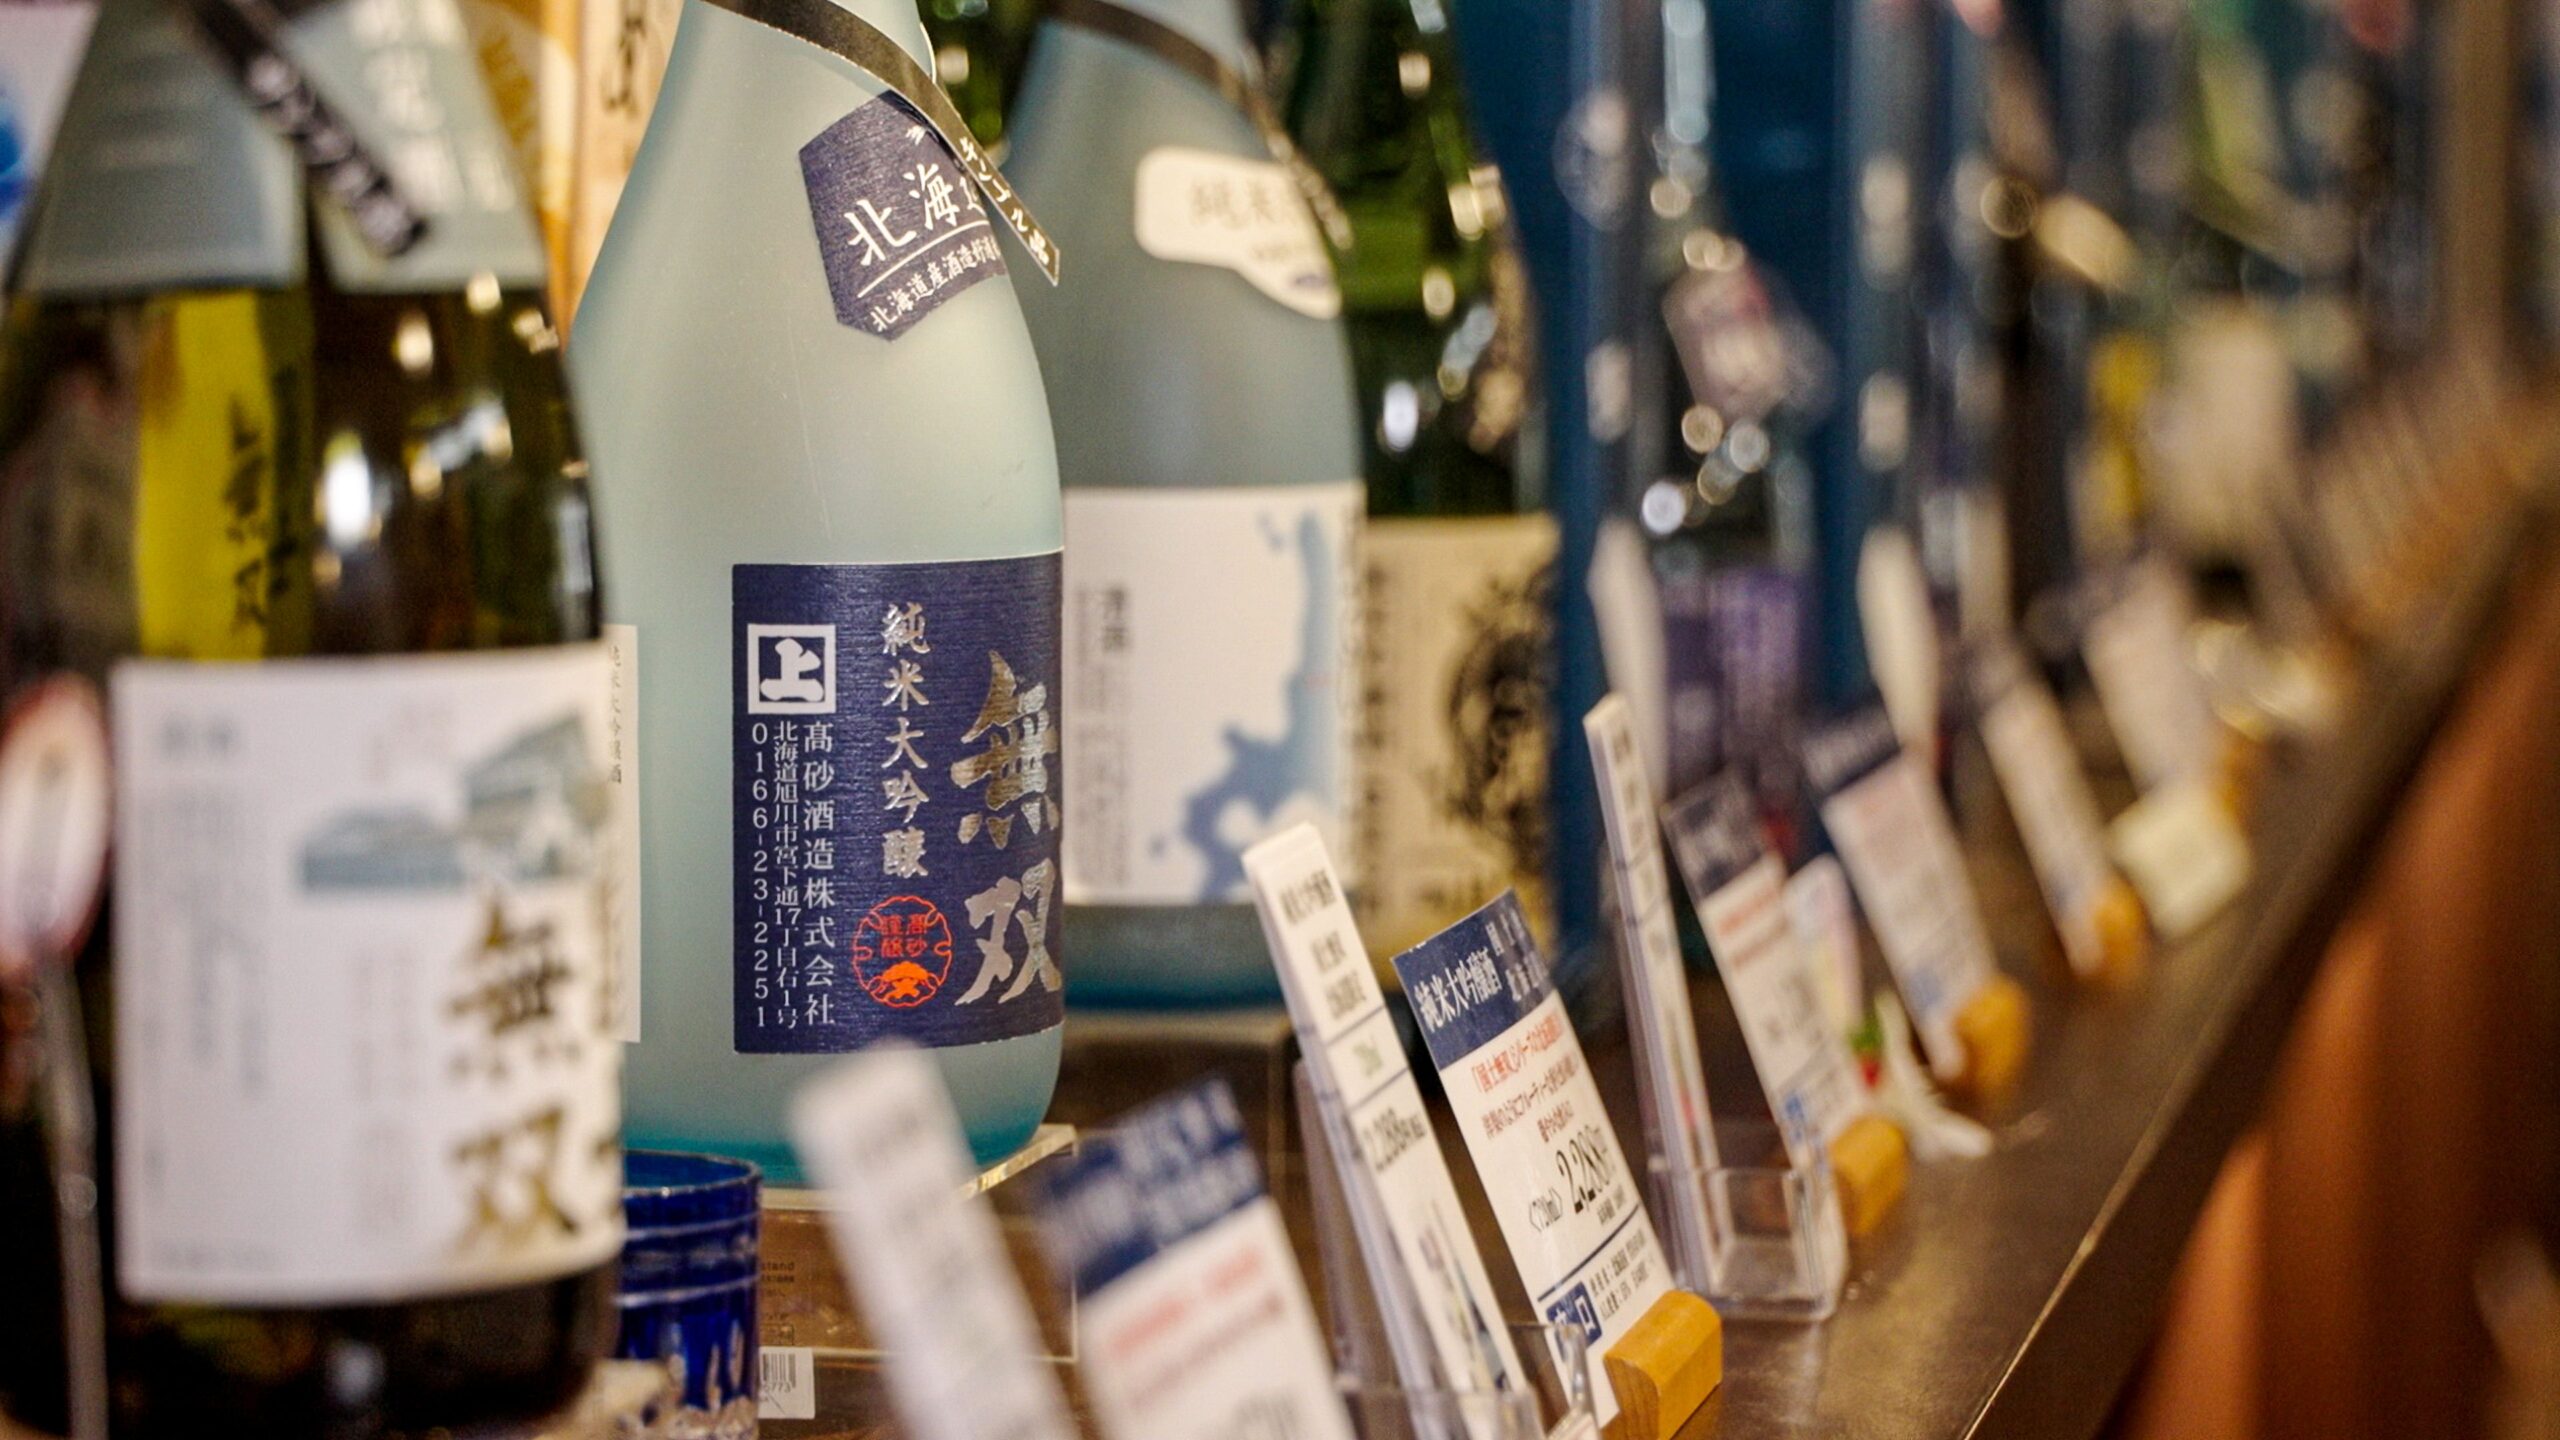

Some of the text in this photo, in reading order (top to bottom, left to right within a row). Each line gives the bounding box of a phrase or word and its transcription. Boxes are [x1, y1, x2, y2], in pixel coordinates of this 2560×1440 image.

[760, 637, 824, 702] 上
[880, 602, 931, 879] 純米大吟醸
[751, 723, 769, 1028] 0166-23-2251
[950, 649, 1061, 1007] 無双
